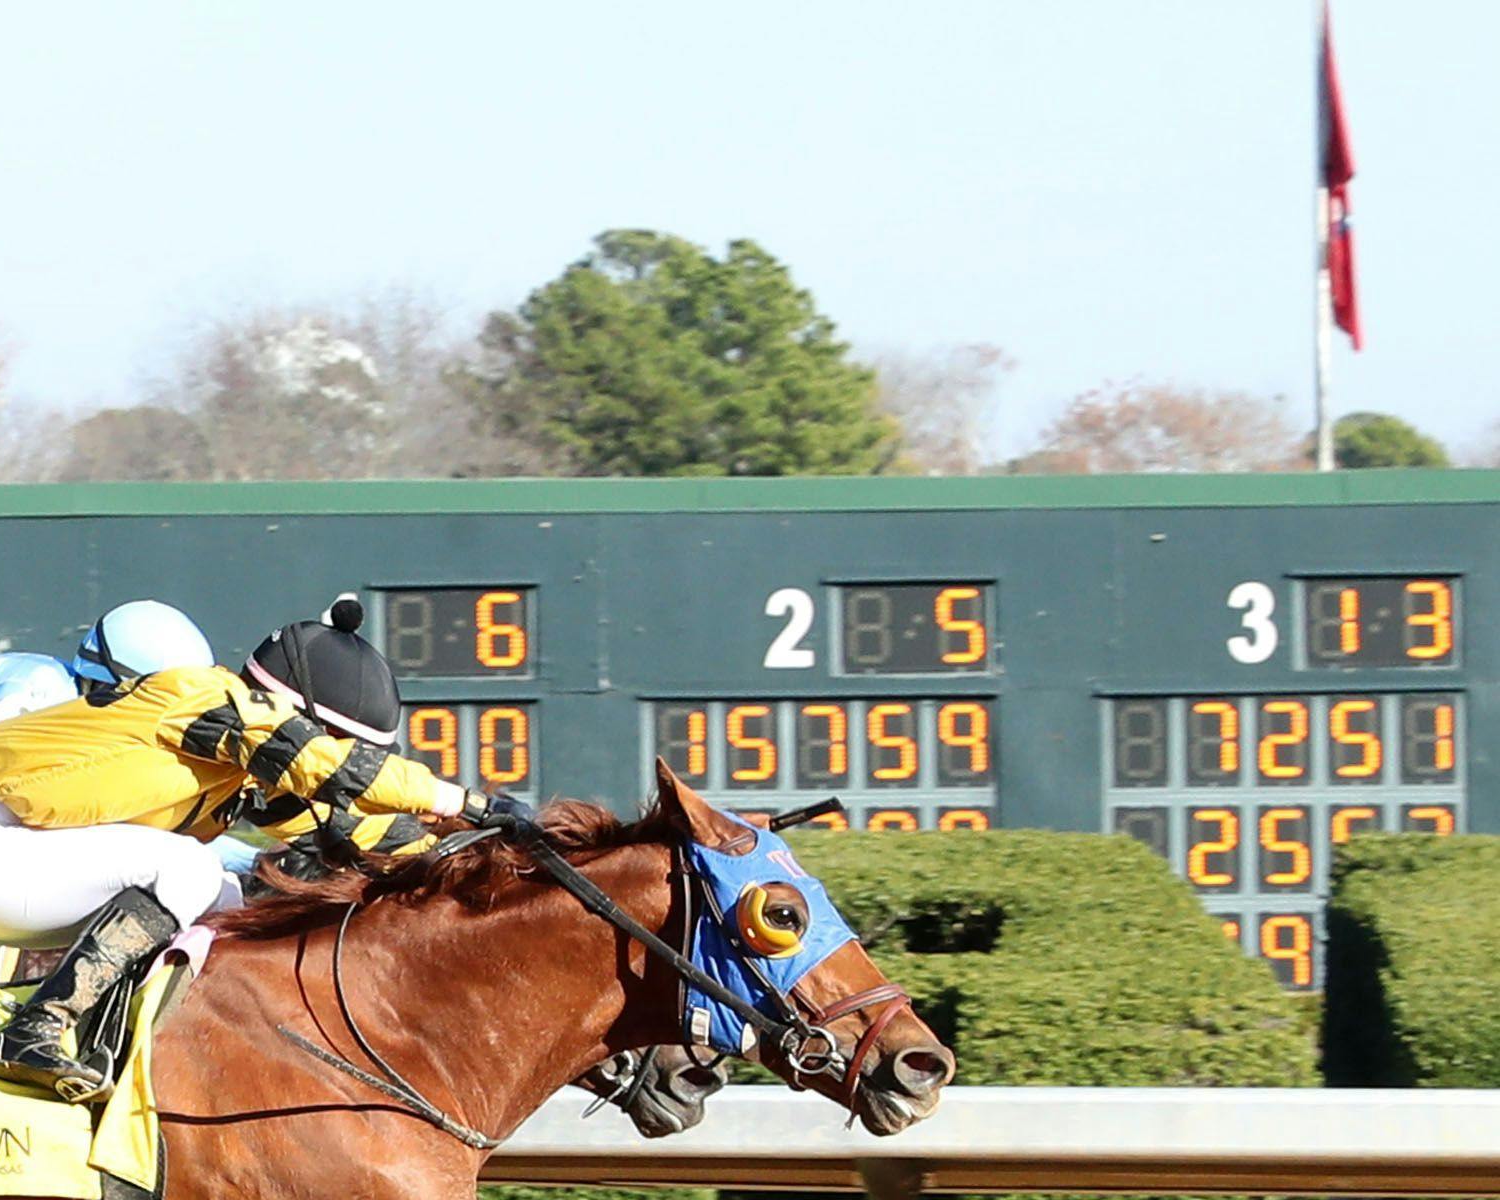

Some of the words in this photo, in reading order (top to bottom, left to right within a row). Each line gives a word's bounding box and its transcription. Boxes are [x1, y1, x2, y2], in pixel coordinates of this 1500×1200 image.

[476, 592, 526, 667] 6
[764, 588, 815, 668] 2
[935, 588, 986, 663] 5
[1226, 581, 1278, 663] 3
[1193, 701, 1454, 777] 7251
